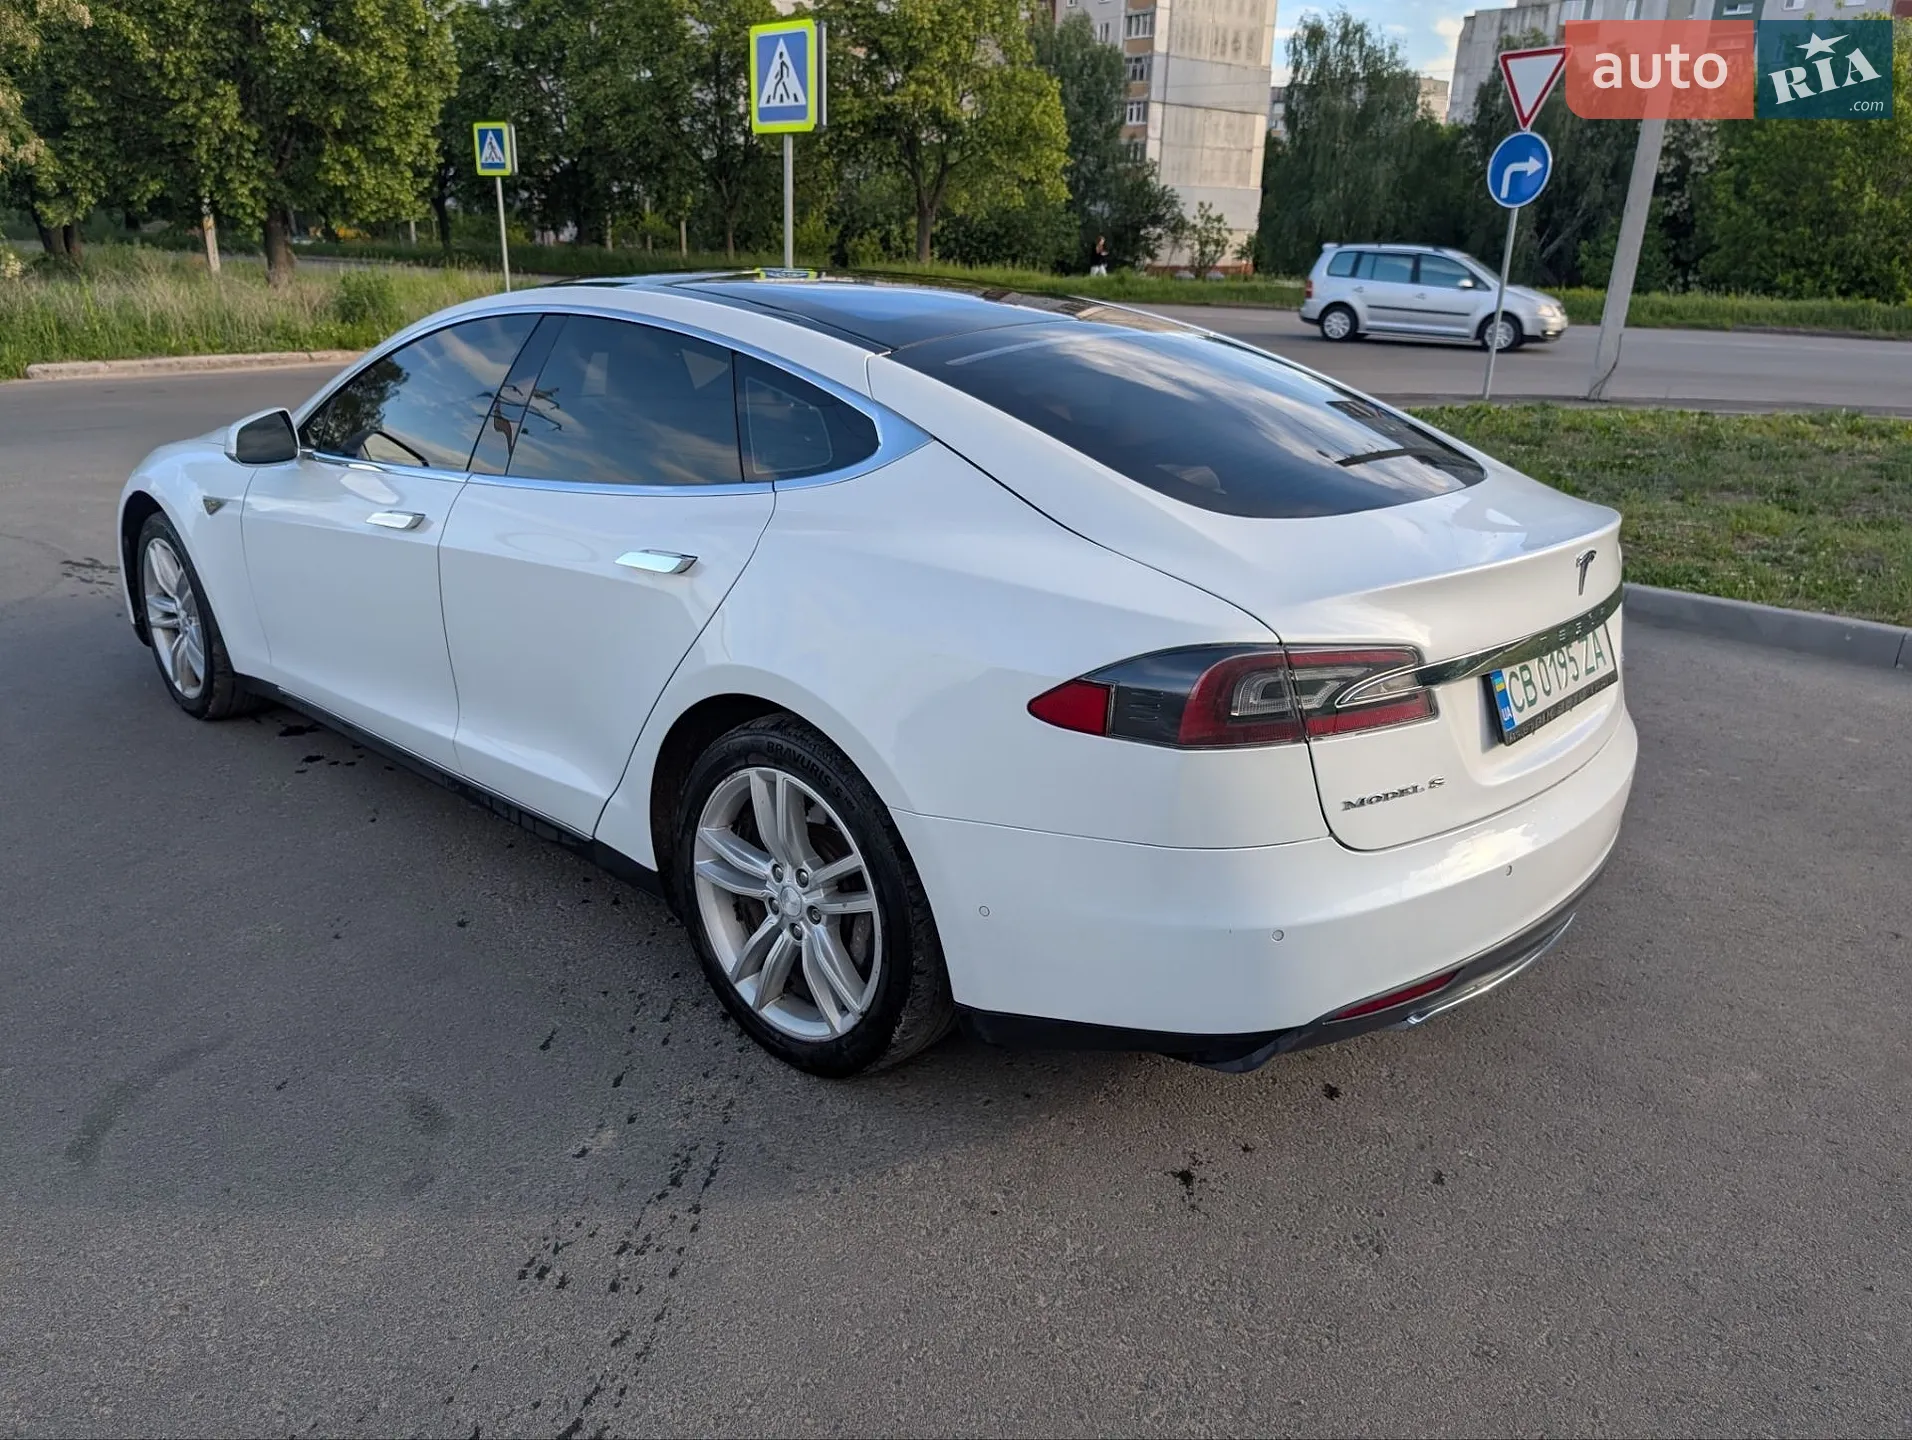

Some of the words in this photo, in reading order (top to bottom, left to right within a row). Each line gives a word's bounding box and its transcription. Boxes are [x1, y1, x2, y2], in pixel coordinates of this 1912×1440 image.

[1508, 663, 1538, 713] CB
[1535, 644, 1579, 697] 0195
[1579, 630, 1607, 676] ZA
[1501, 705, 1513, 721] UA
[766, 740, 832, 788] BRAVURIS
[1341, 784, 1425, 812] MODEL
[1428, 776, 1446, 790] S
